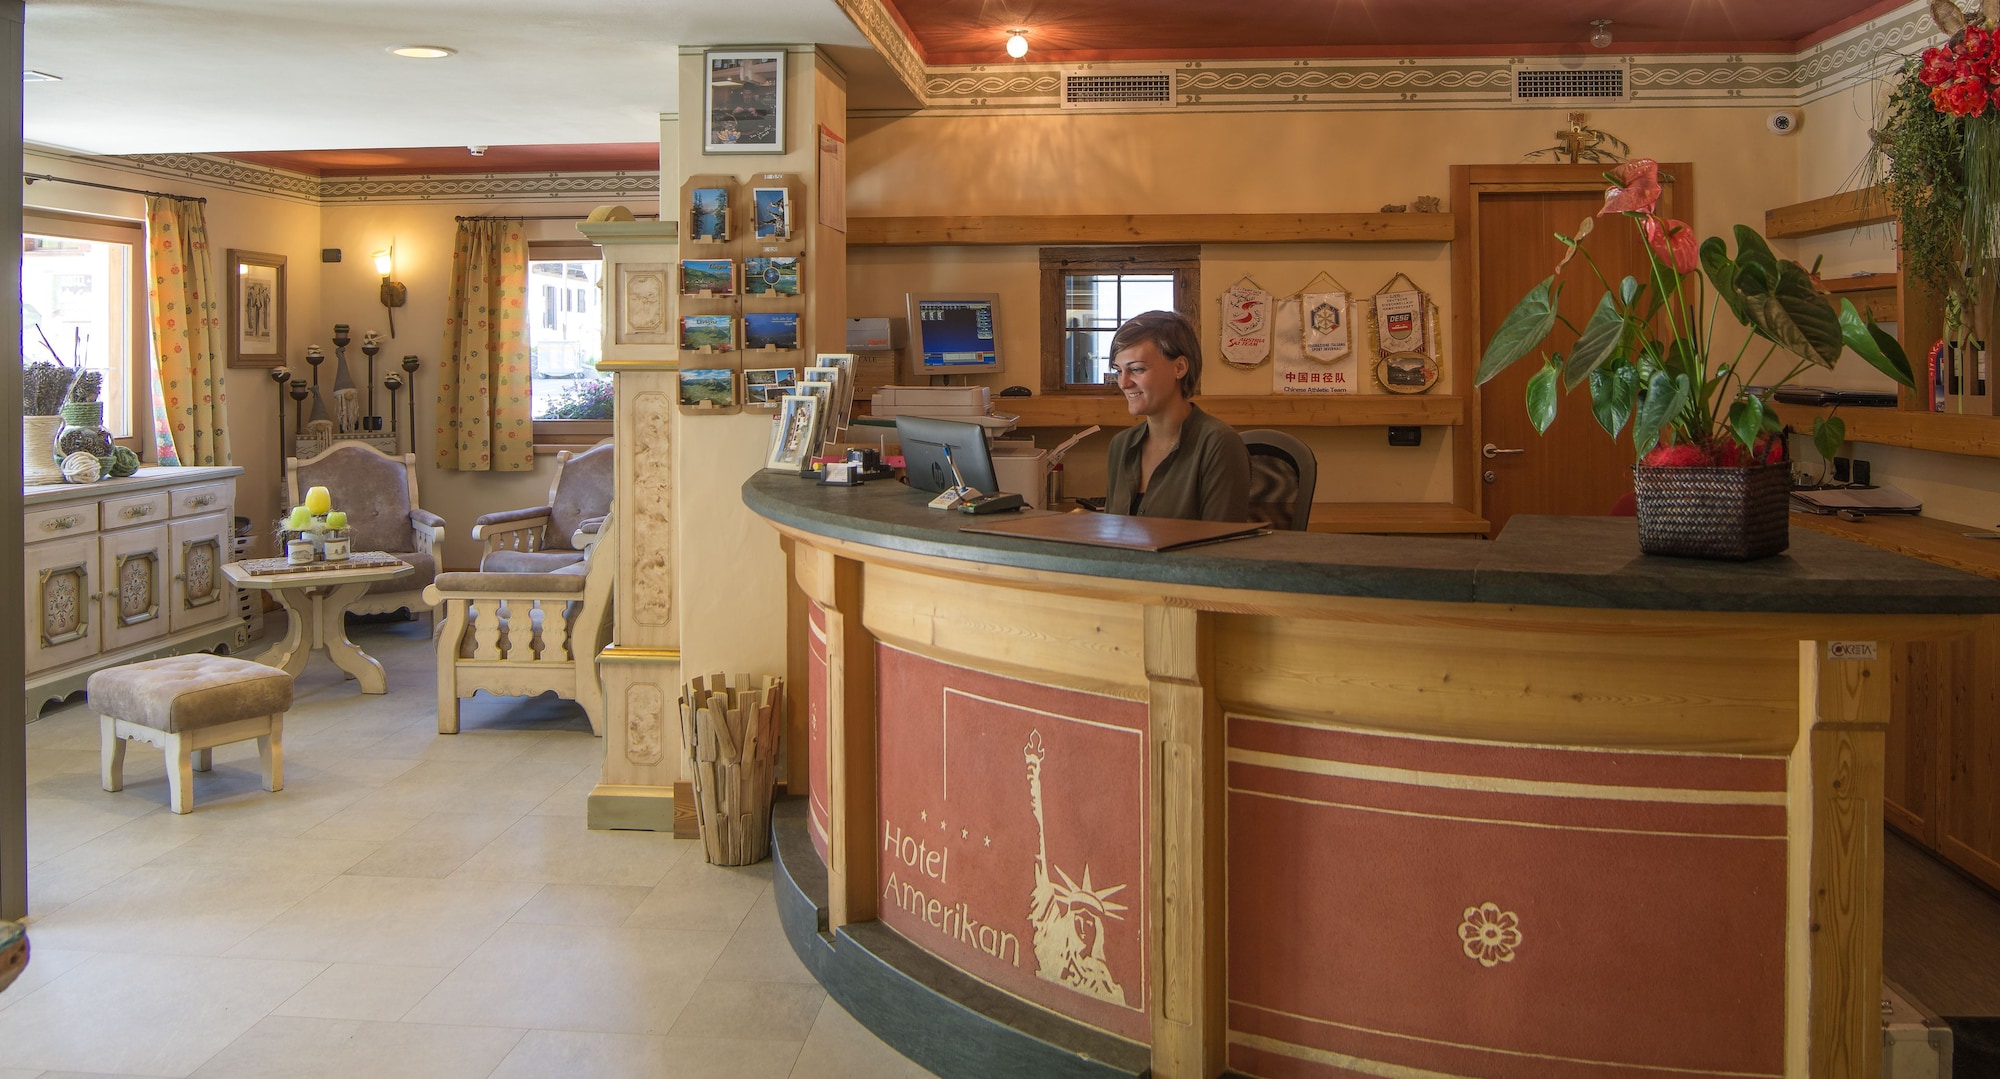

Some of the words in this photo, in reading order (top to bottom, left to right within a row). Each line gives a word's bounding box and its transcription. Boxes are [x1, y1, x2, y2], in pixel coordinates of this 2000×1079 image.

[1389, 314, 1410, 322] DESG
[1227, 338, 1240, 347] SKI
[1285, 371, 1346, 383] 中国田径队
[883, 819, 949, 883] Hotel
[882, 871, 1021, 969] Amerikan
